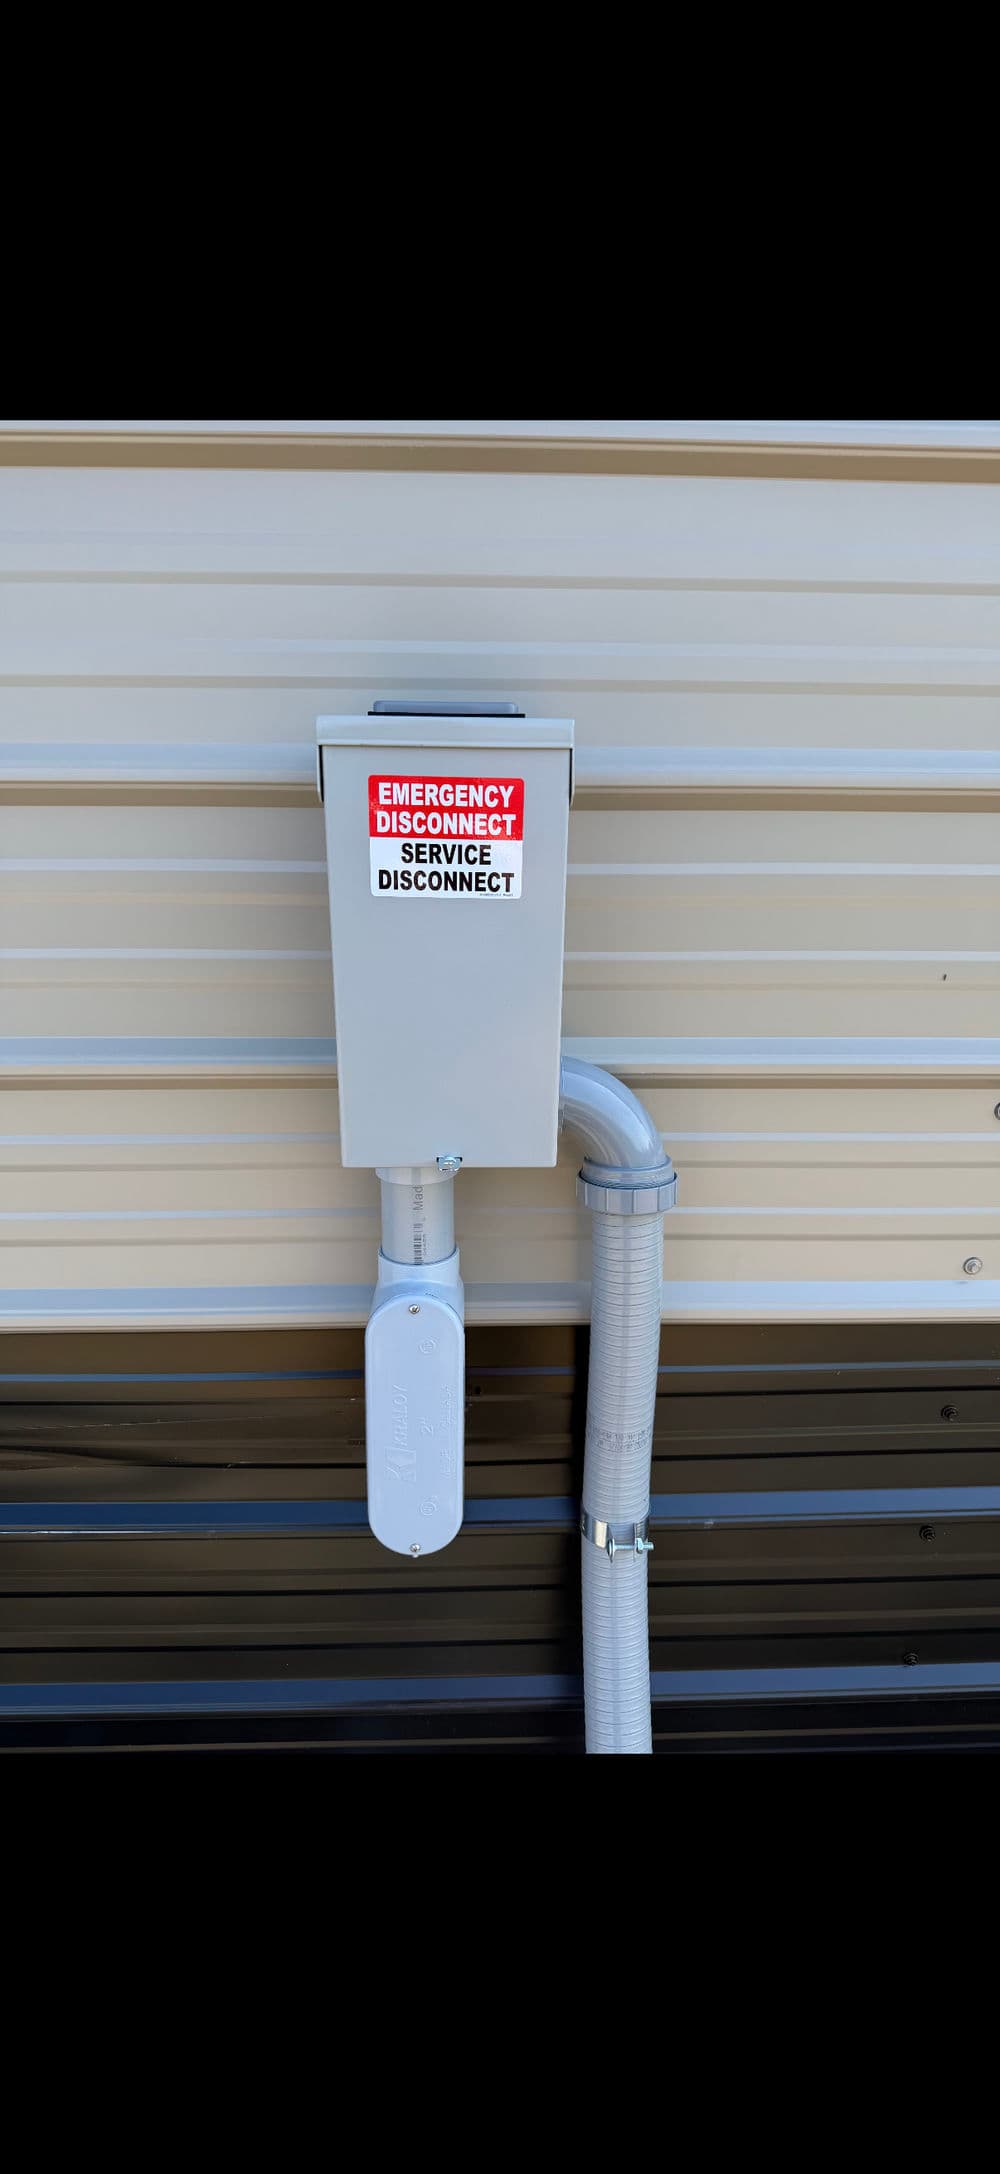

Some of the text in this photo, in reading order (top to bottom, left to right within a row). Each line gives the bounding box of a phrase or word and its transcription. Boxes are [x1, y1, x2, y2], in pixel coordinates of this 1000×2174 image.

[378, 782, 514, 808] EMERGENCY
[376, 811, 516, 836] DISCONNECT
[401, 842, 492, 866] SERVICE
[378, 869, 515, 893] DISCONNECT
